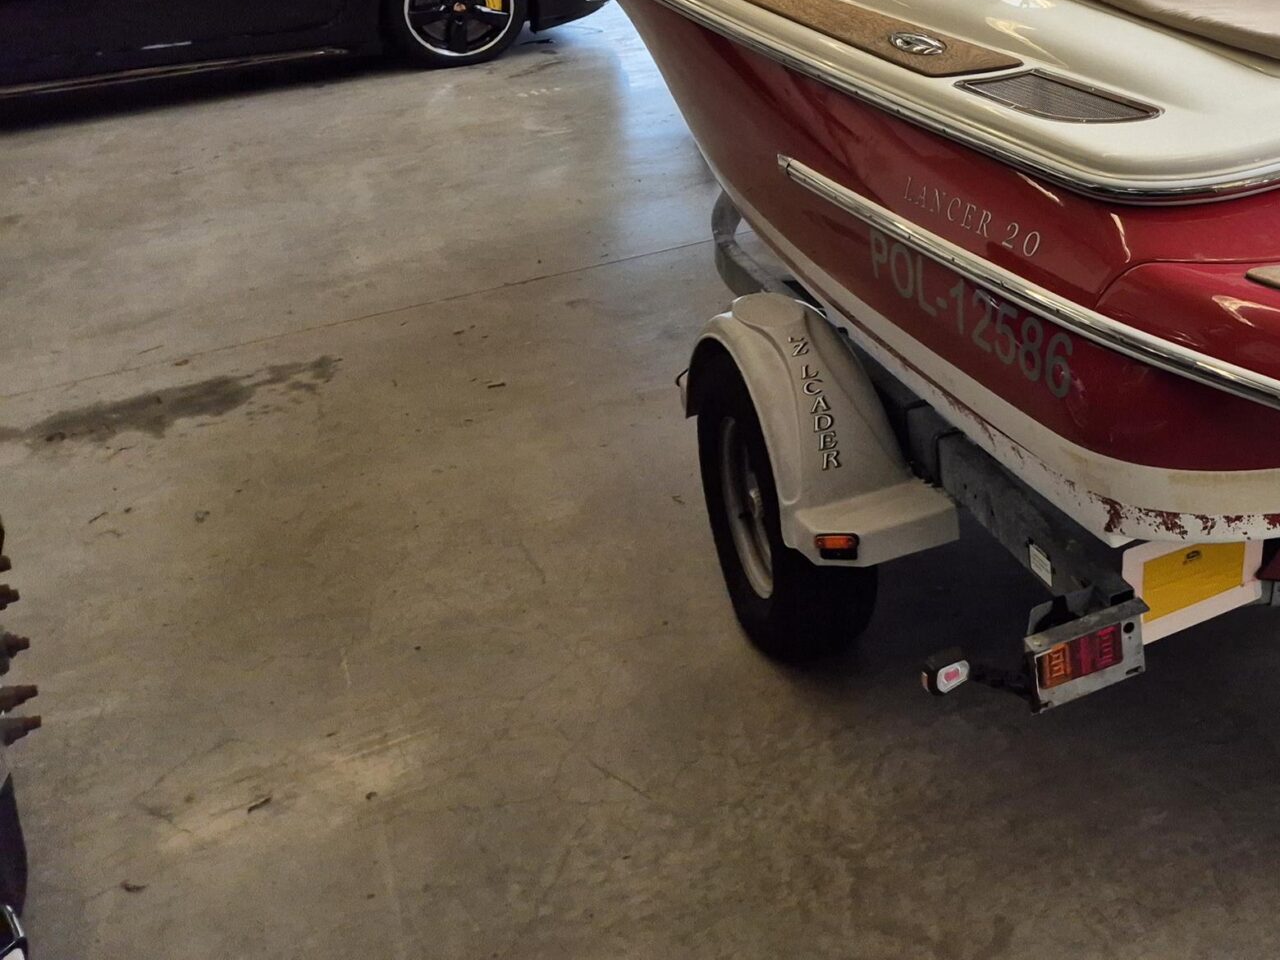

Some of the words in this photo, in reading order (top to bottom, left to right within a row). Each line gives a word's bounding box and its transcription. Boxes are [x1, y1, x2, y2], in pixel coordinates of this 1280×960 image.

[904, 176, 993, 238] LANCER
[1002, 222, 1041, 257] 20
[869, 227, 1073, 399] POL-12586
